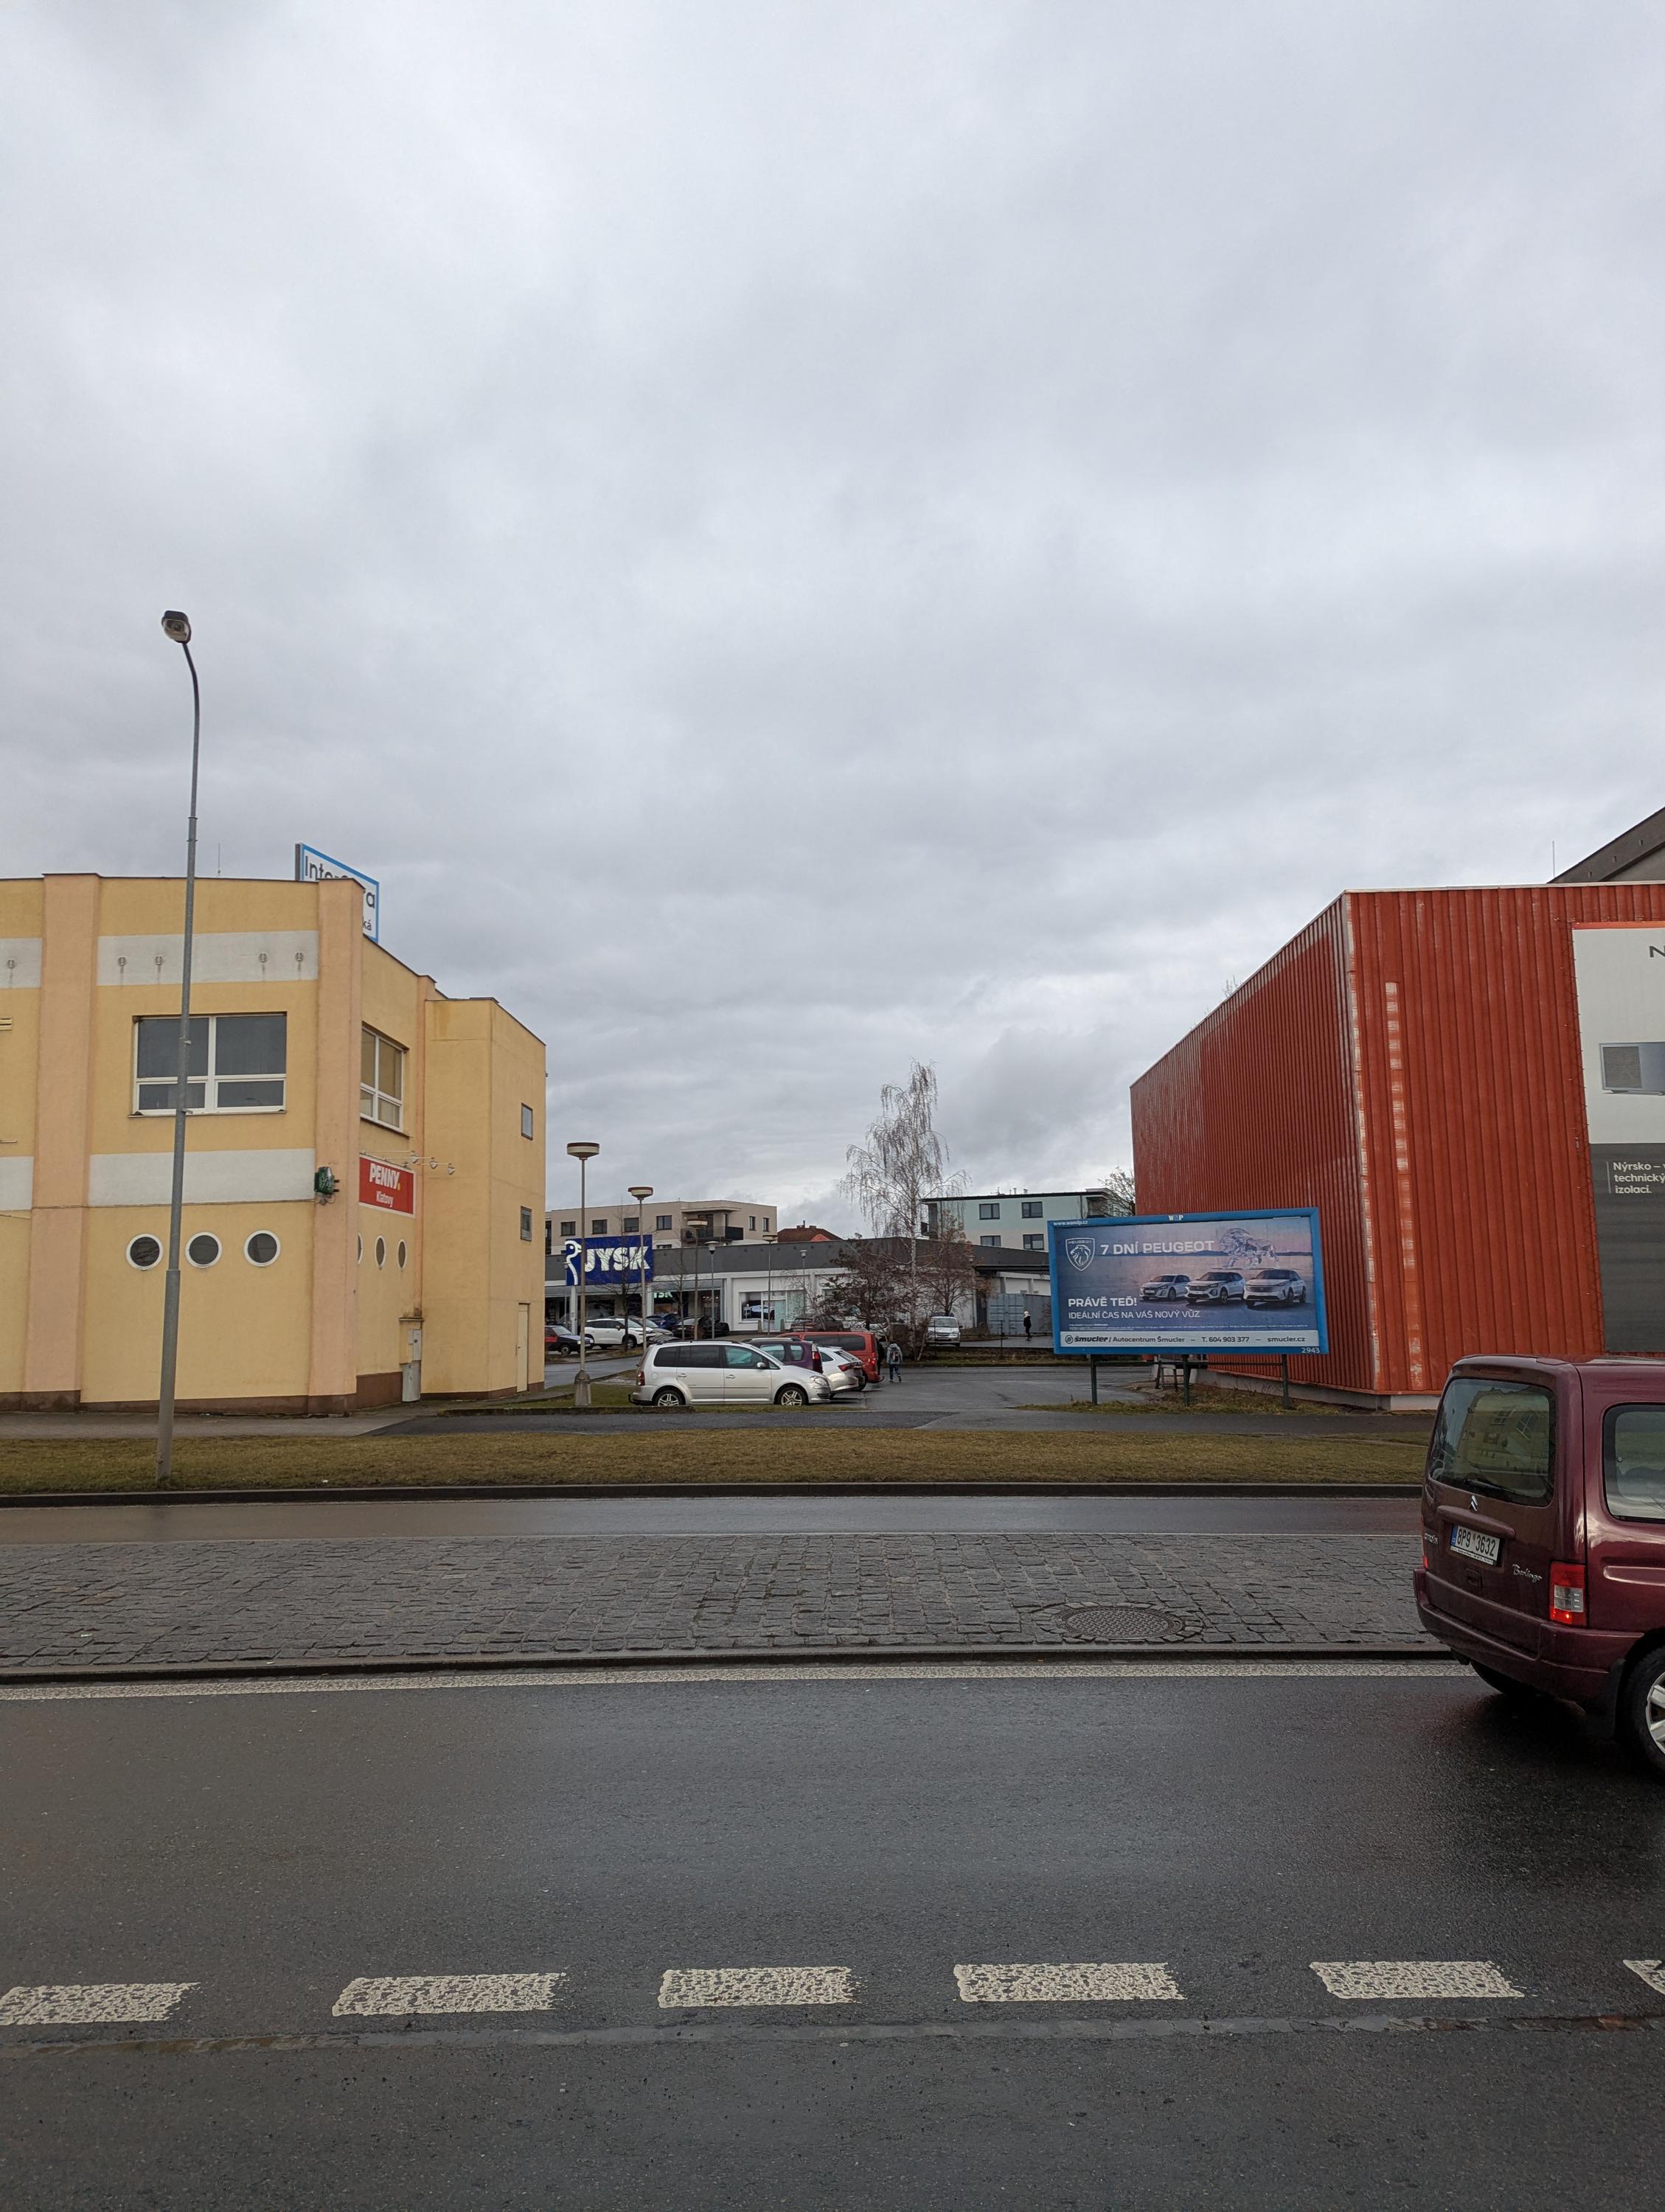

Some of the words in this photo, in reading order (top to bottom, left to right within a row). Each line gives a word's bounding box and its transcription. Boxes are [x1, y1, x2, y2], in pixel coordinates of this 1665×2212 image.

[1613, 1162, 1651, 1172] Nýrsko
[376, 1191, 394, 1207] Klatovy
[1100, 1245, 1109, 1255] 7
[1113, 1242, 1139, 1254] DNÍ
[1143, 1240, 1214, 1253] PEUGEOT
[585, 1246, 650, 1273] JYSK
[1068, 1297, 1107, 1307] PRÁVĚ
[1110, 1296, 1137, 1307] TEĎ!
[1069, 1311, 1100, 1319] IDEÁLNÍ
[1102, 1310, 1119, 1318] ČAS
[1136, 1310, 1153, 1318] VÁŠ
[1155, 1310, 1180, 1318] NOVÝ
[1182, 1309, 1200, 1318] VŮZ
[1457, 1528, 1471, 1548] 8P9
[1475, 1534, 1496, 1557] 3632
[1512, 1564, 1543, 1583] Berlingo
